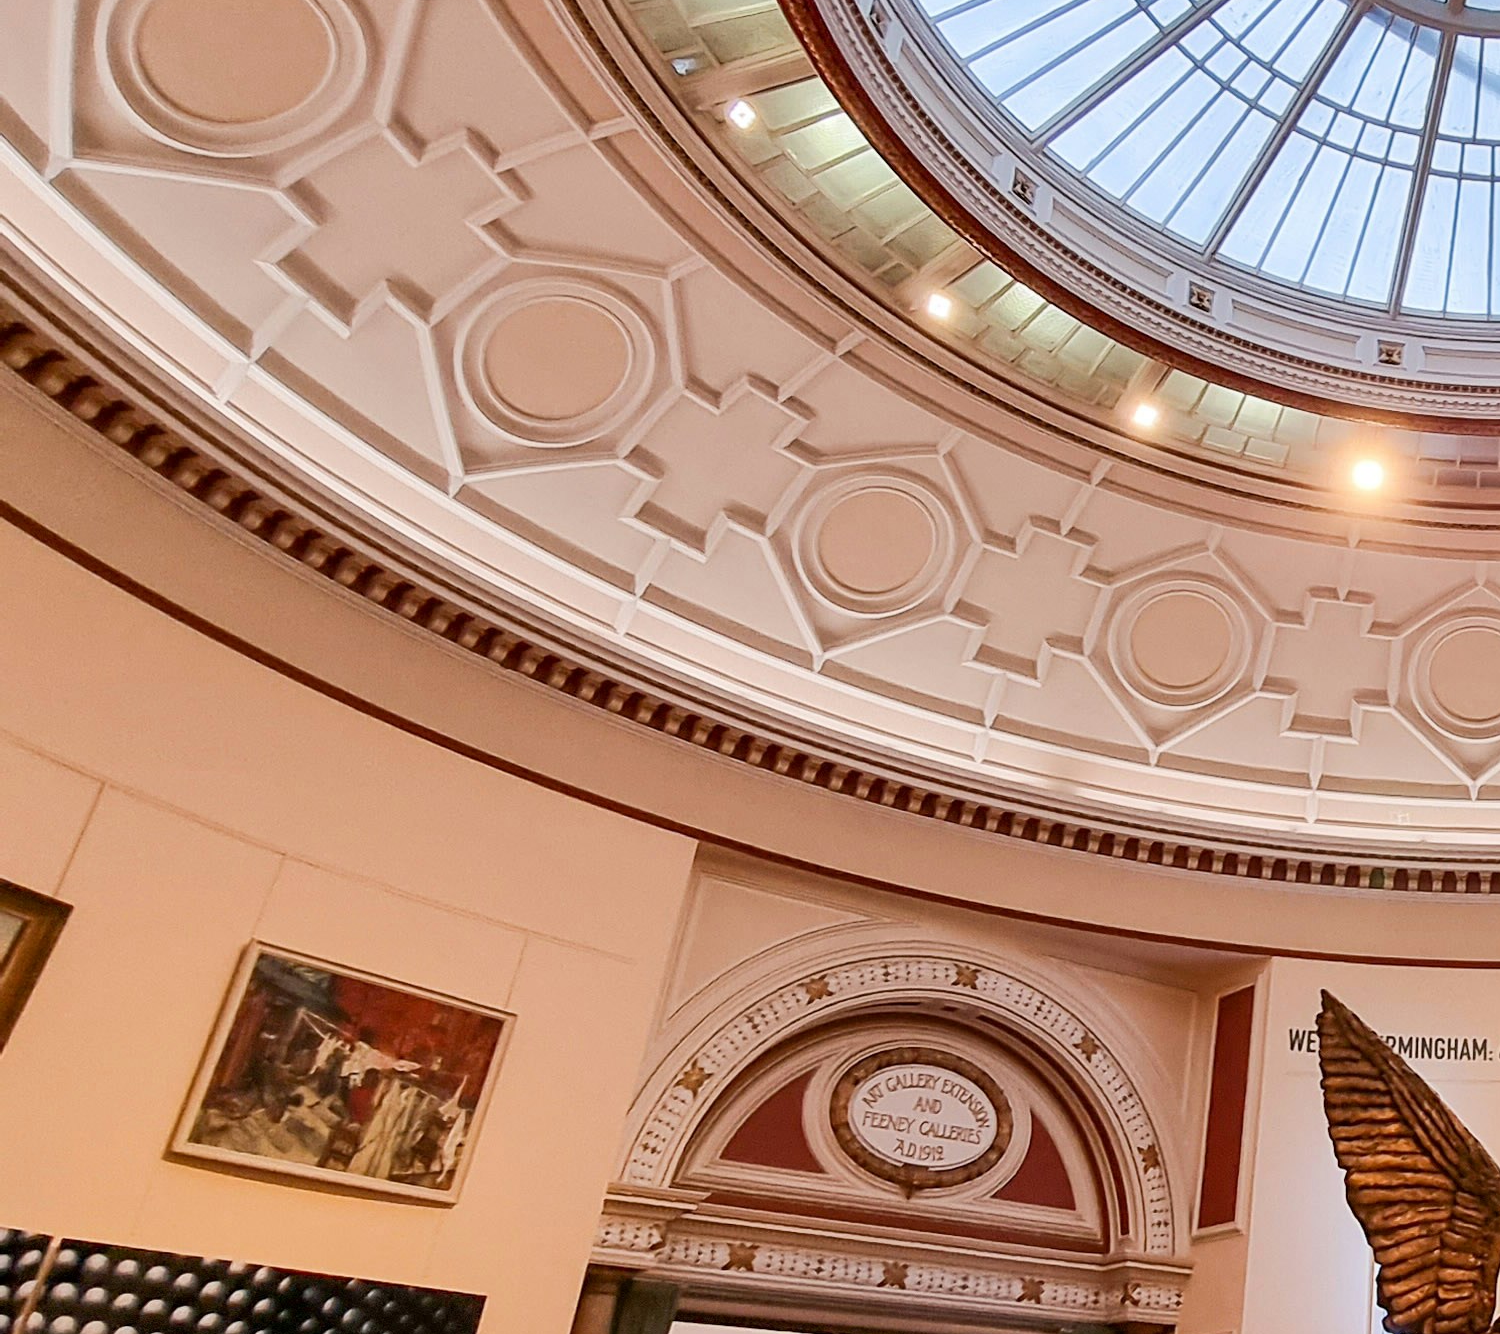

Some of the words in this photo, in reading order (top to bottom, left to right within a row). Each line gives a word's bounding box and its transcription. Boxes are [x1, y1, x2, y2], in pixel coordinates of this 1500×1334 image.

[1289, 1029, 1318, 1053] WE
[862, 1082, 884, 1109] ART
[885, 1072, 942, 1093] GALLERY
[940, 1079, 990, 1129] EXTENSION
[913, 1096, 943, 1115] AND
[862, 1111, 916, 1134] FEENEY
